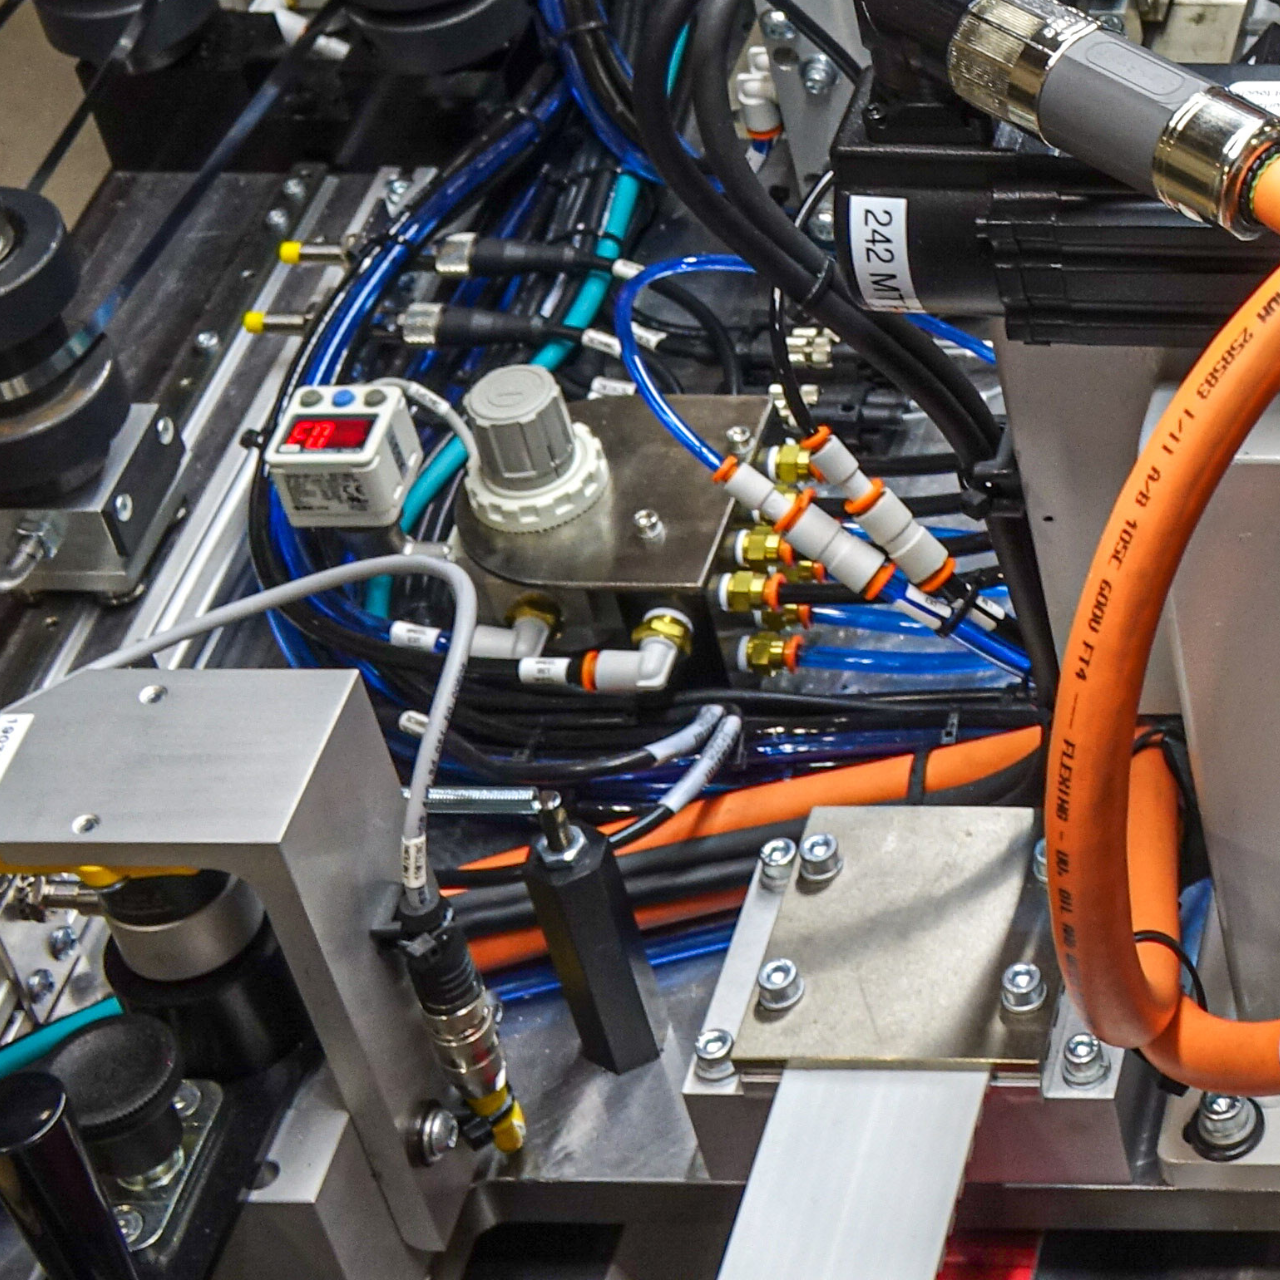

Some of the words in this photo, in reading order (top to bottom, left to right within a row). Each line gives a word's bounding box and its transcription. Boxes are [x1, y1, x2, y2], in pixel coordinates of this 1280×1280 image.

[864, 208, 895, 263] 242
[1196, 327, 1254, 400] 258583
[1135, 466, 1161, 508] A/B
[1108, 518, 1138, 572] 105C
[1086, 578, 1113, 640] 600V
[1074, 642, 1096, 682] FT4
[1054, 739, 1078, 822] FLEXING
